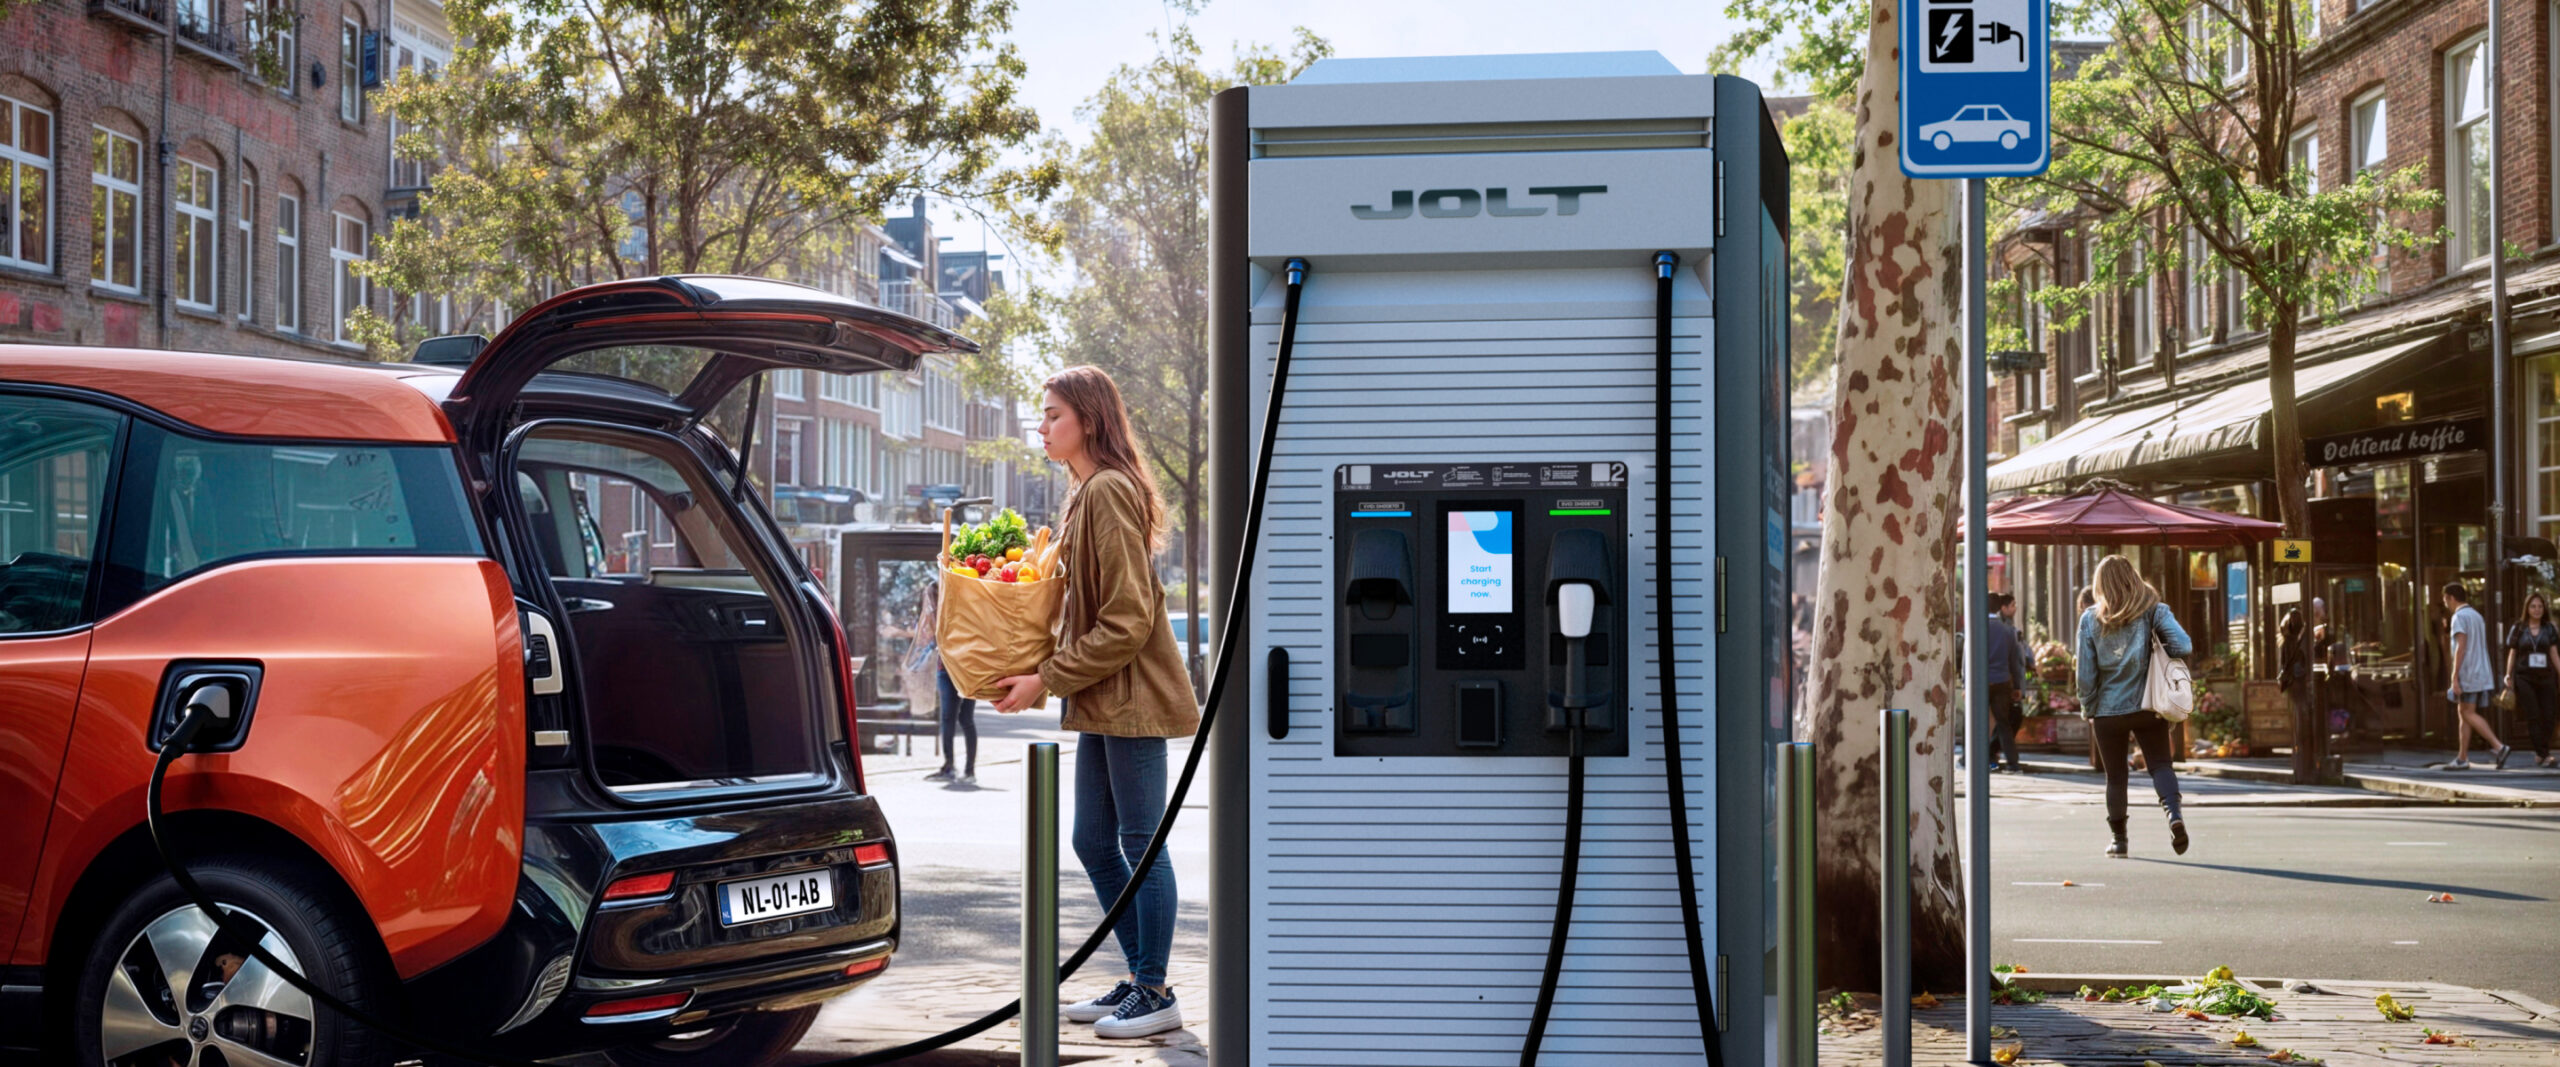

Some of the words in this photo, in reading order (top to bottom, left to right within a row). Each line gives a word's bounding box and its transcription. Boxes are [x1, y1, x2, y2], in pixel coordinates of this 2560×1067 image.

[1350, 185, 1608, 220] JOLT
[2408, 426, 2466, 451] koffie
[1338, 465, 1347, 485] 1
[1383, 470, 1434, 478] JOLT
[1611, 463, 1625, 482] 2
[1470, 564, 1492, 573] Start
[1460, 577, 1502, 587] charging
[741, 877, 821, 915] NL-01-AB
